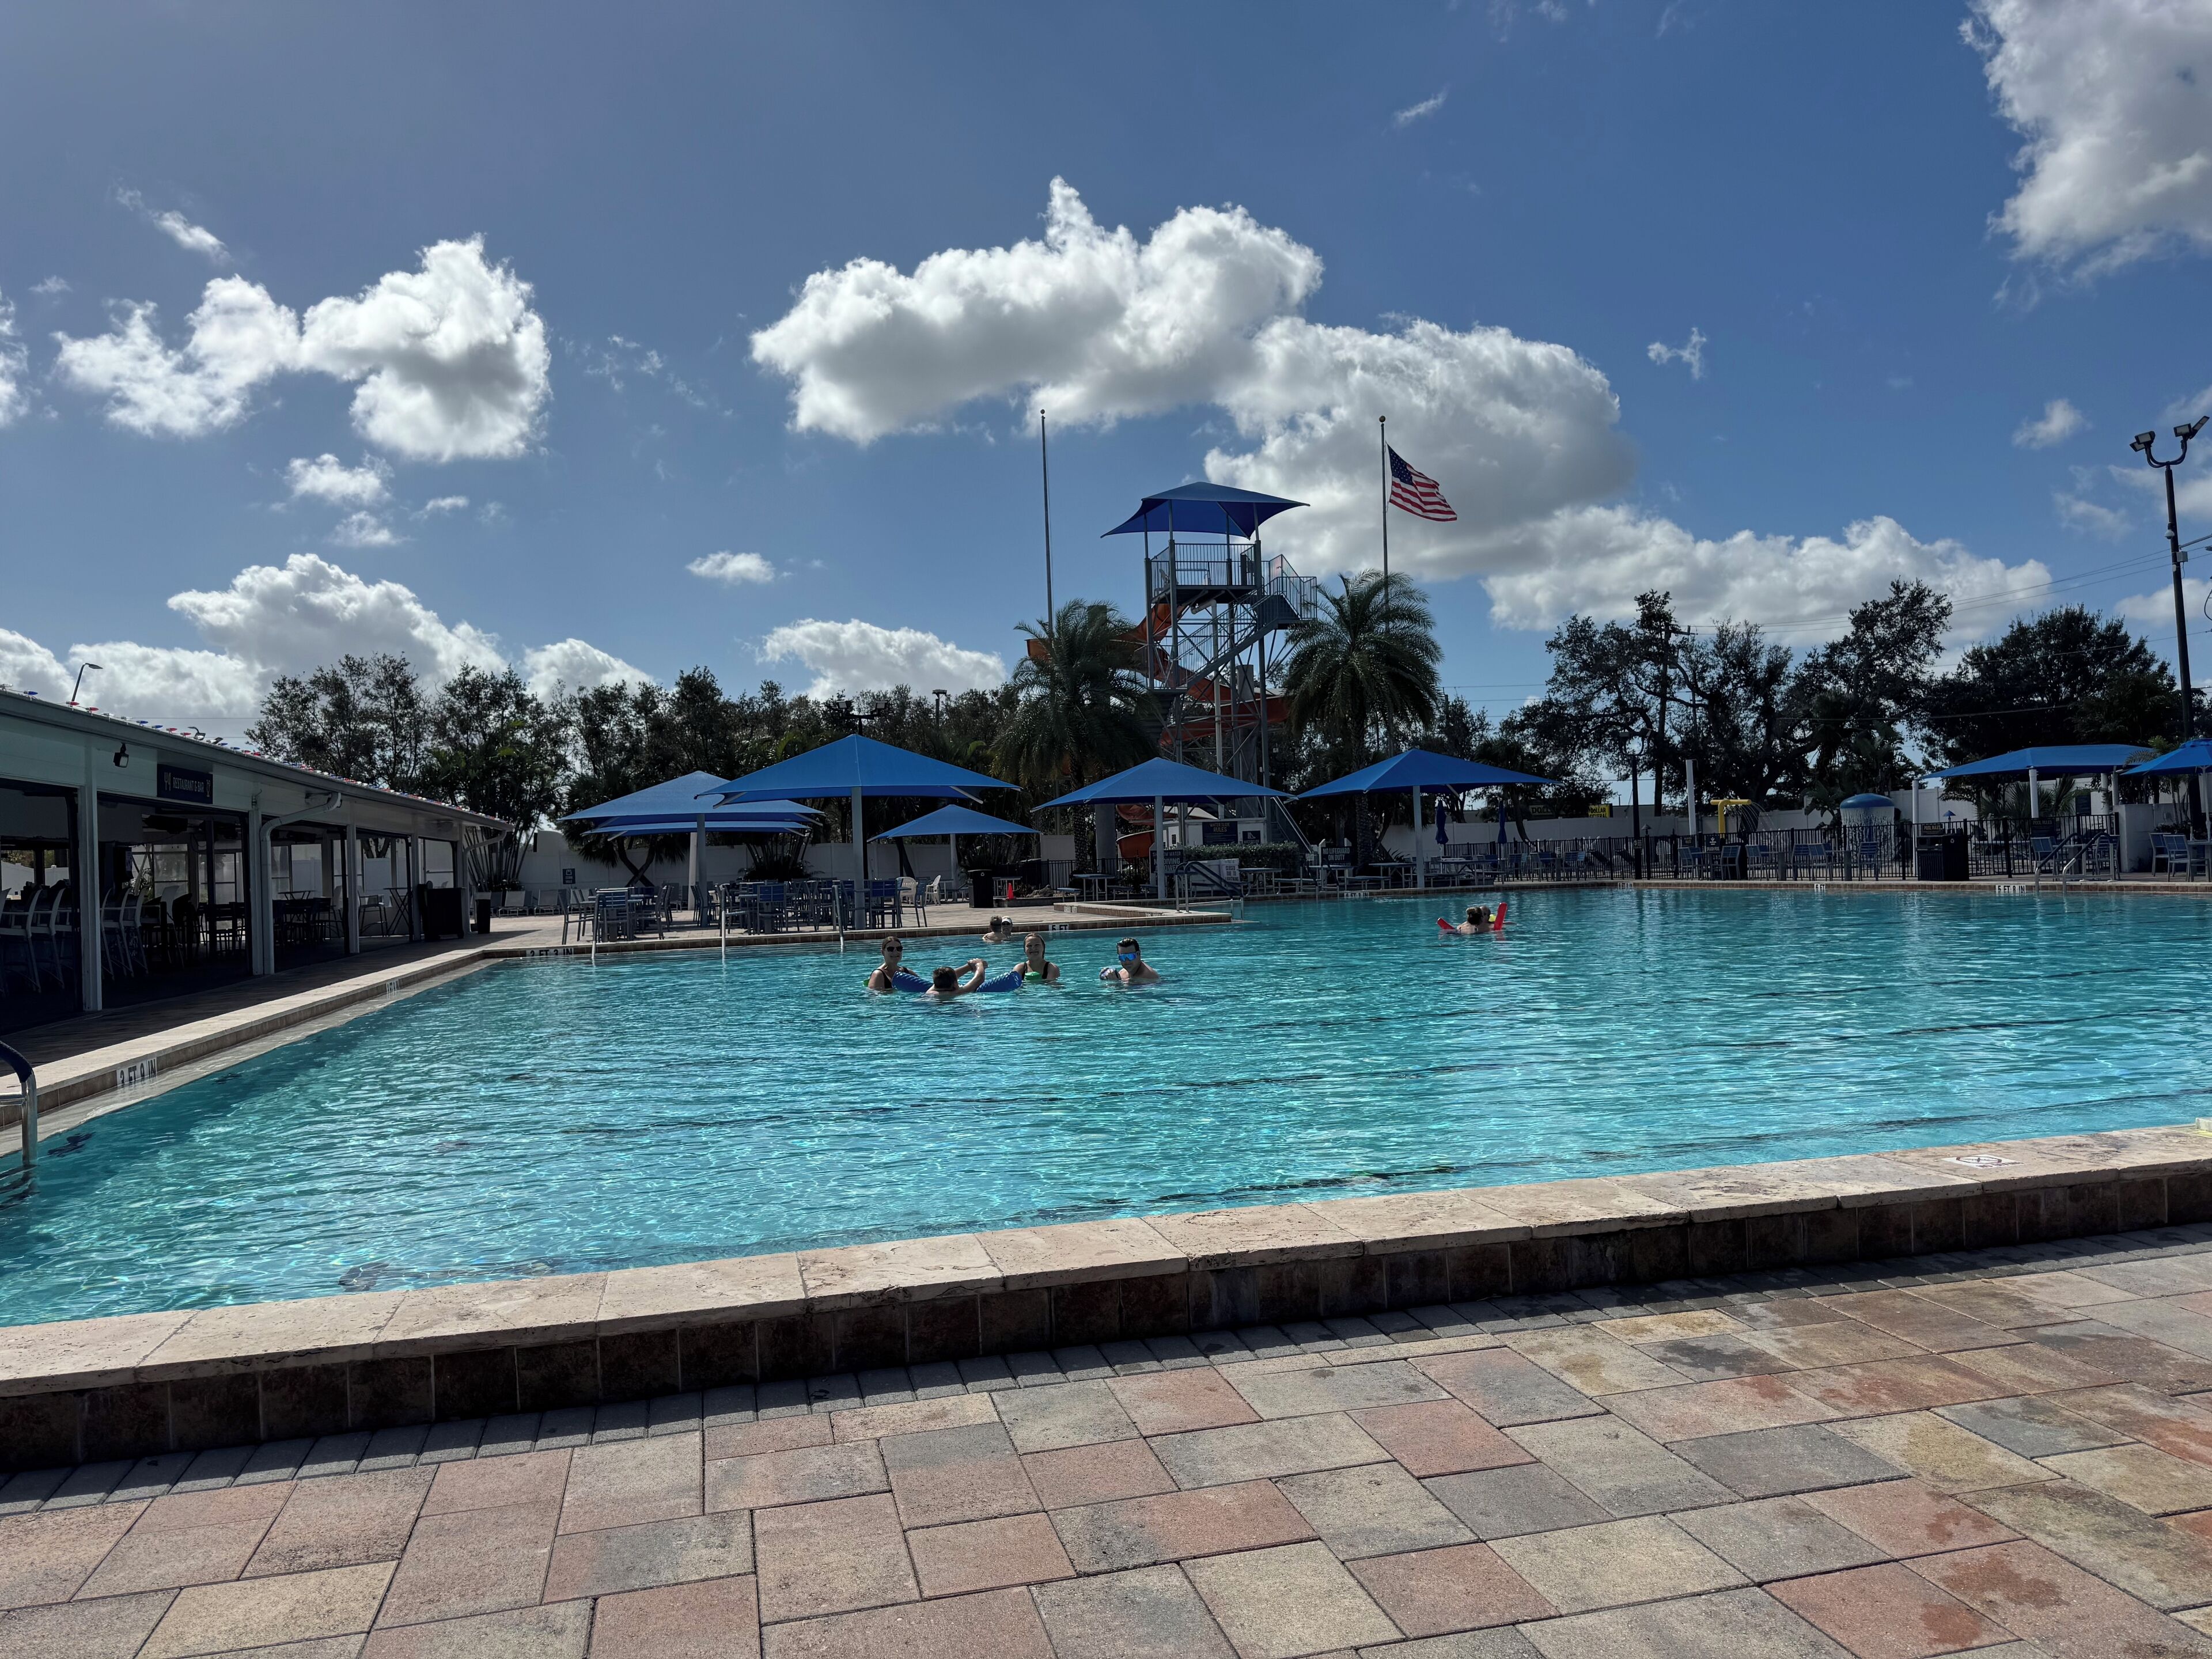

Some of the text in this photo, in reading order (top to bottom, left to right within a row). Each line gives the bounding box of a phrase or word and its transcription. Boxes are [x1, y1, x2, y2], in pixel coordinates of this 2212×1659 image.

[173, 777, 194, 791] RESTAURANT
[194, 781, 197, 792] &
[128, 1065, 137, 1082] FT
[148, 1059, 156, 1078] IN
